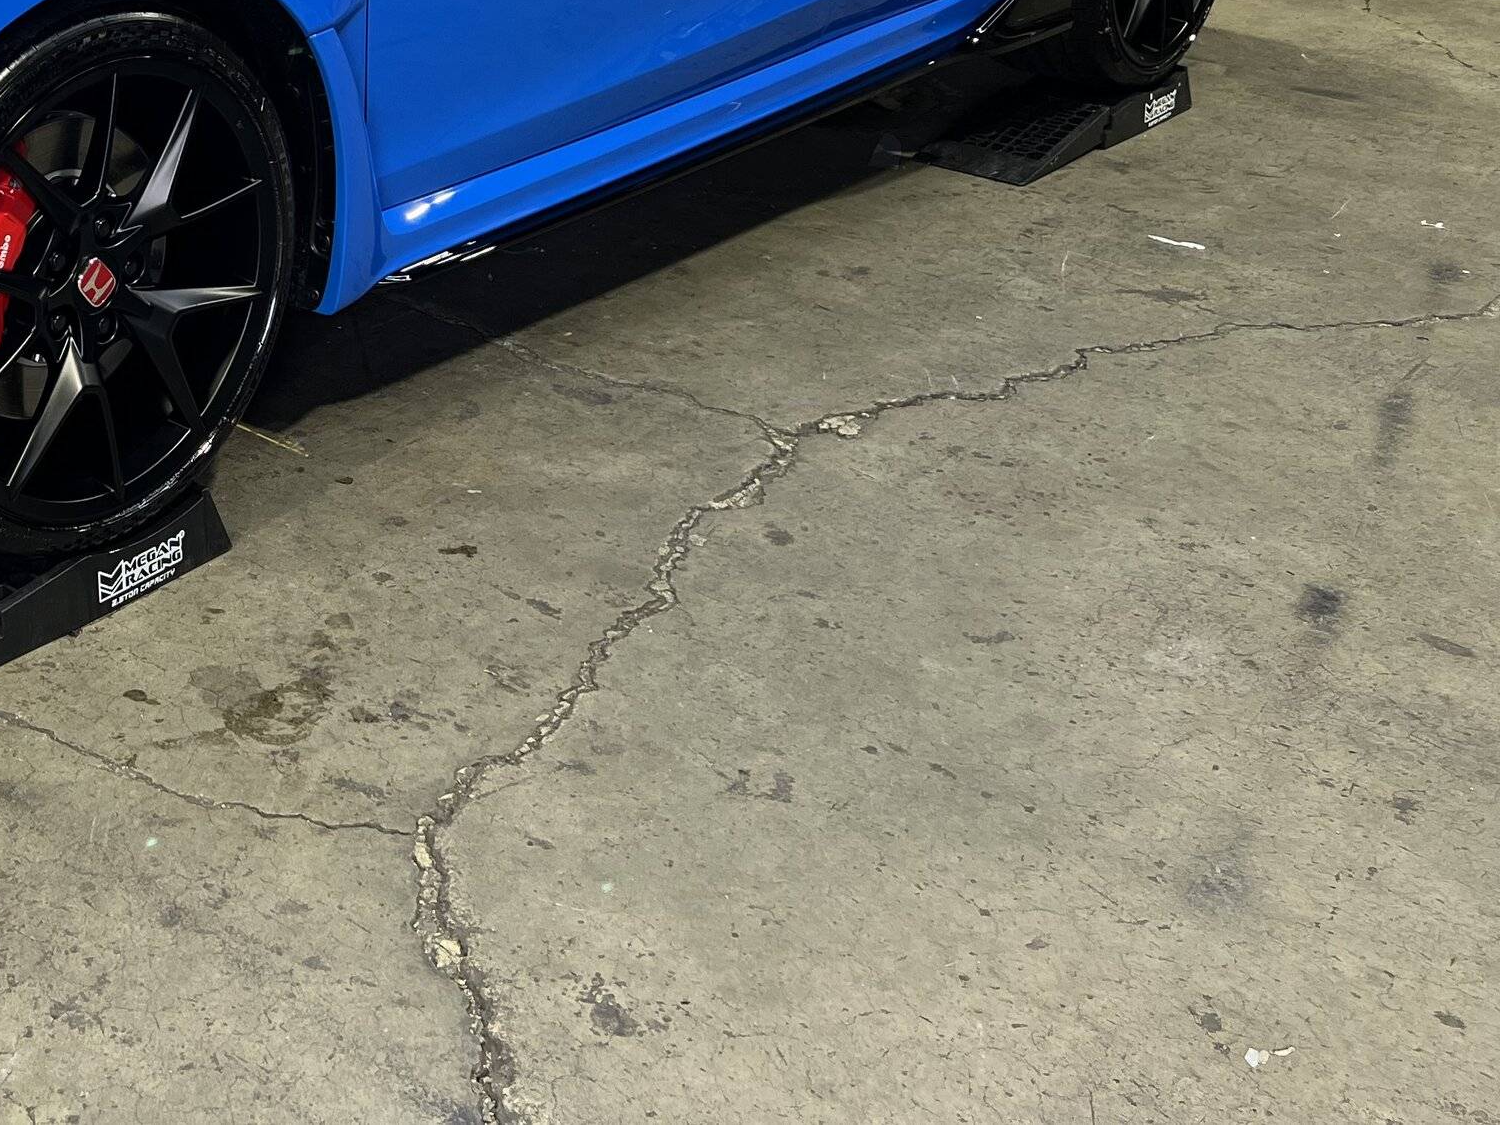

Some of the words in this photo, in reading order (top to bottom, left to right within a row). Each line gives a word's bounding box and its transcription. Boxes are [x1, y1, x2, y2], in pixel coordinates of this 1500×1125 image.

[124, 539, 181, 574] MEGAN
[124, 548, 182, 588] RACING
[140, 567, 176, 593] CAPACITY
